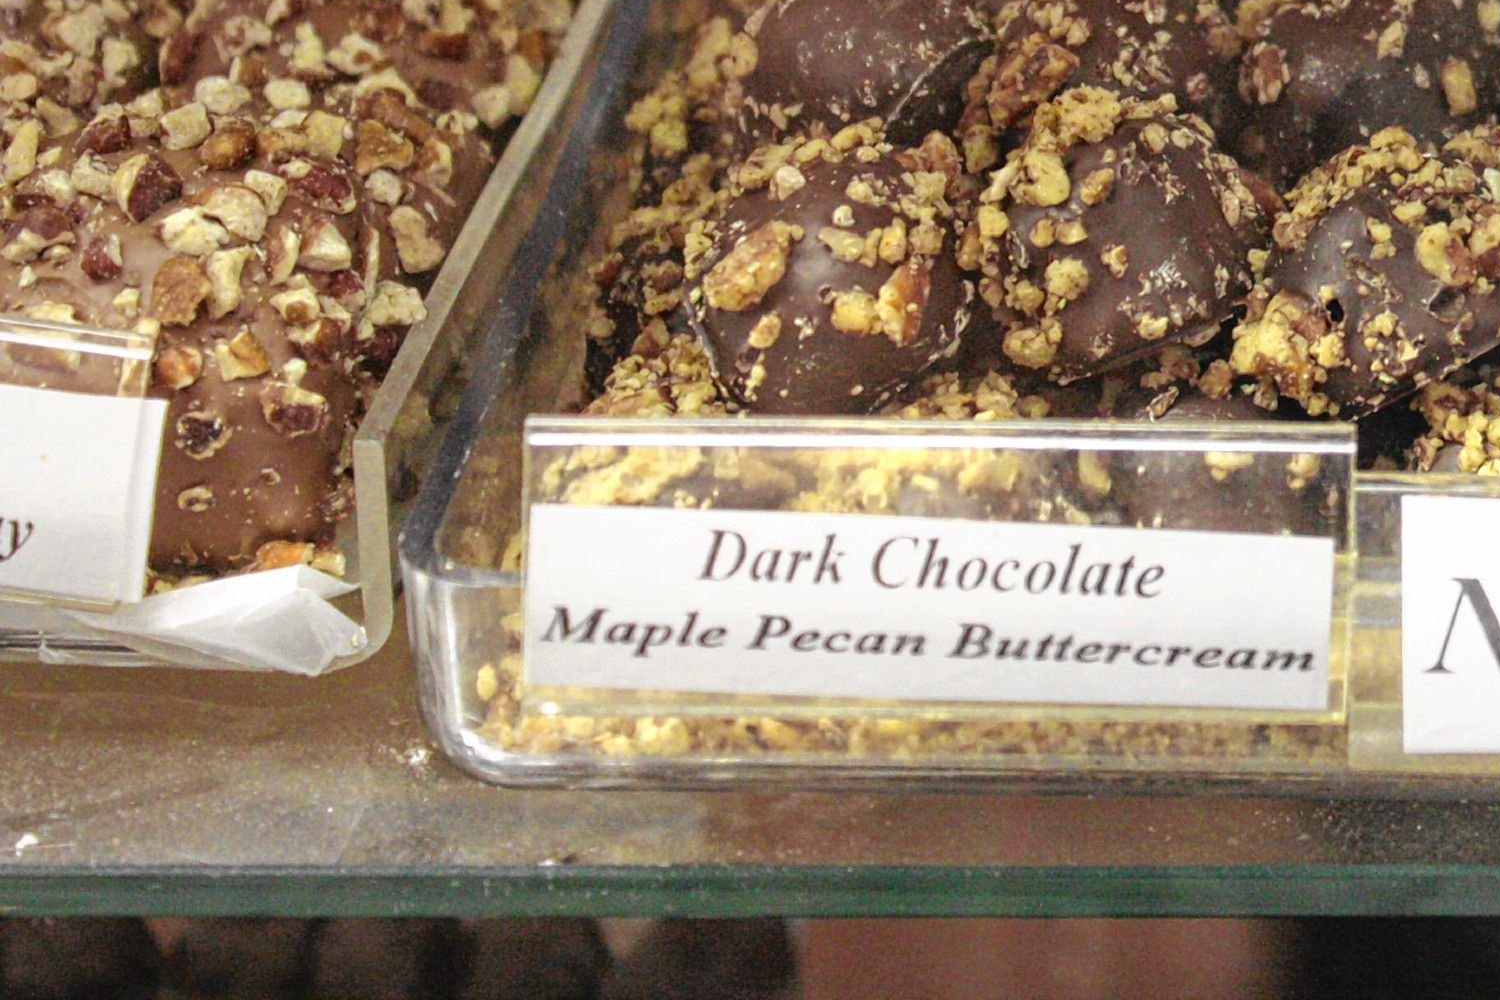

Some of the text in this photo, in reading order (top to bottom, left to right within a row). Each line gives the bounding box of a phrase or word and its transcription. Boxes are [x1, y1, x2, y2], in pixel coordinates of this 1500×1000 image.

[698, 529, 1166, 599] Dark Chocolate
[538, 605, 1316, 673] Maple Pecan Buttercream
